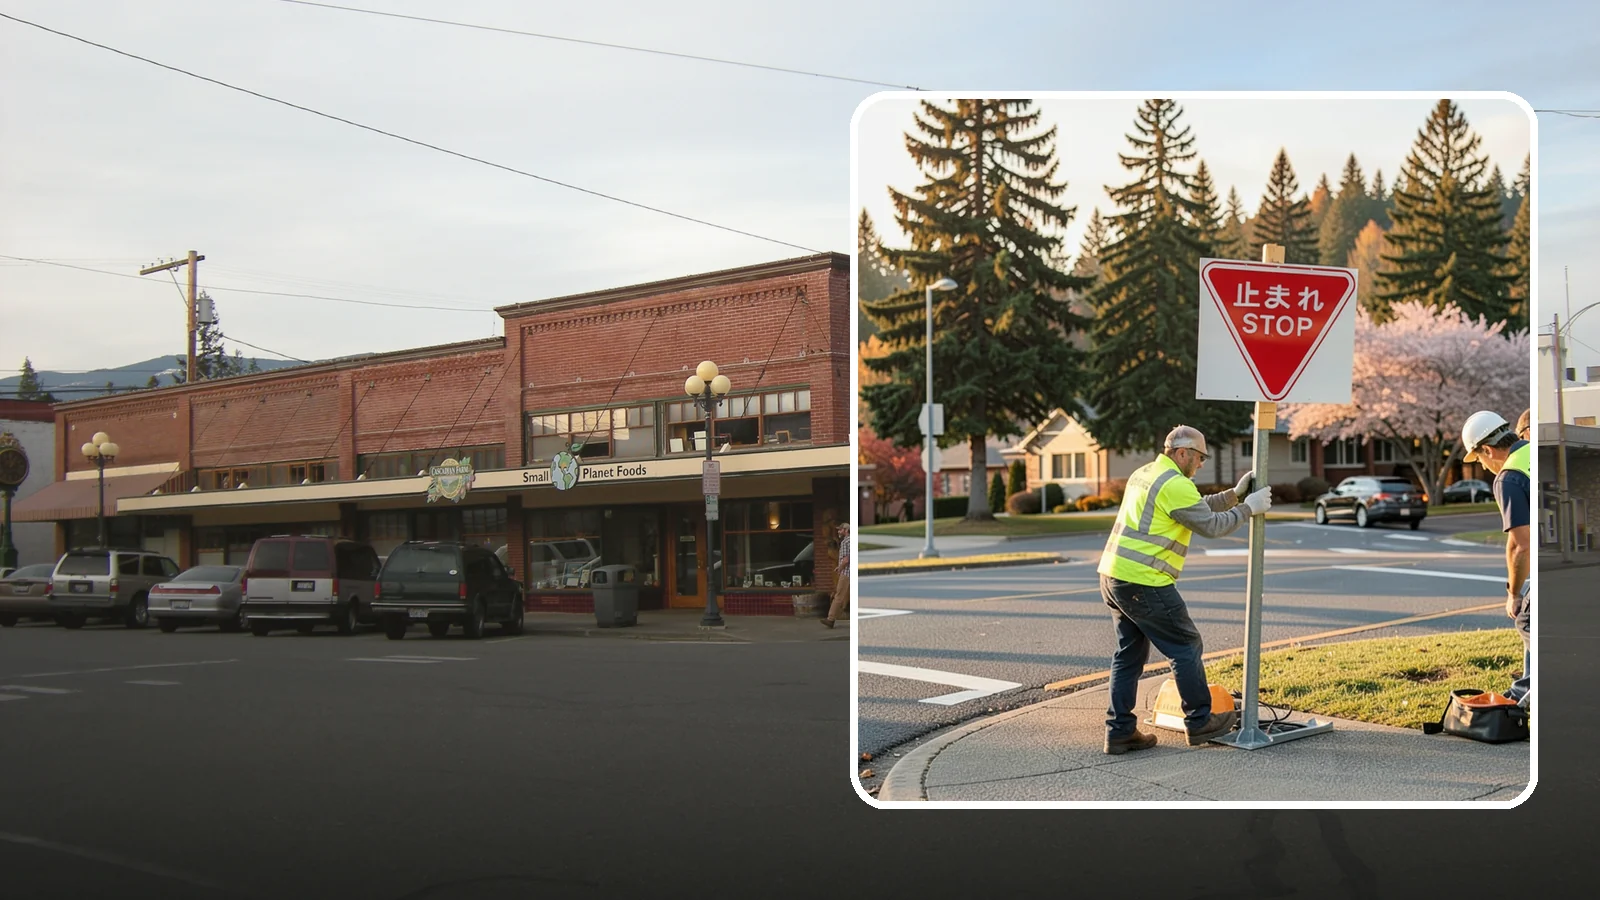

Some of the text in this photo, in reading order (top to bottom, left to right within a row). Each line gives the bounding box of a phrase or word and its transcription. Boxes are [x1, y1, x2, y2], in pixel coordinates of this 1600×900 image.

[1233, 281, 1324, 312] 止まれ
[1242, 313, 1313, 337] STOP
[523, 464, 647, 483] Small Planet Foods
